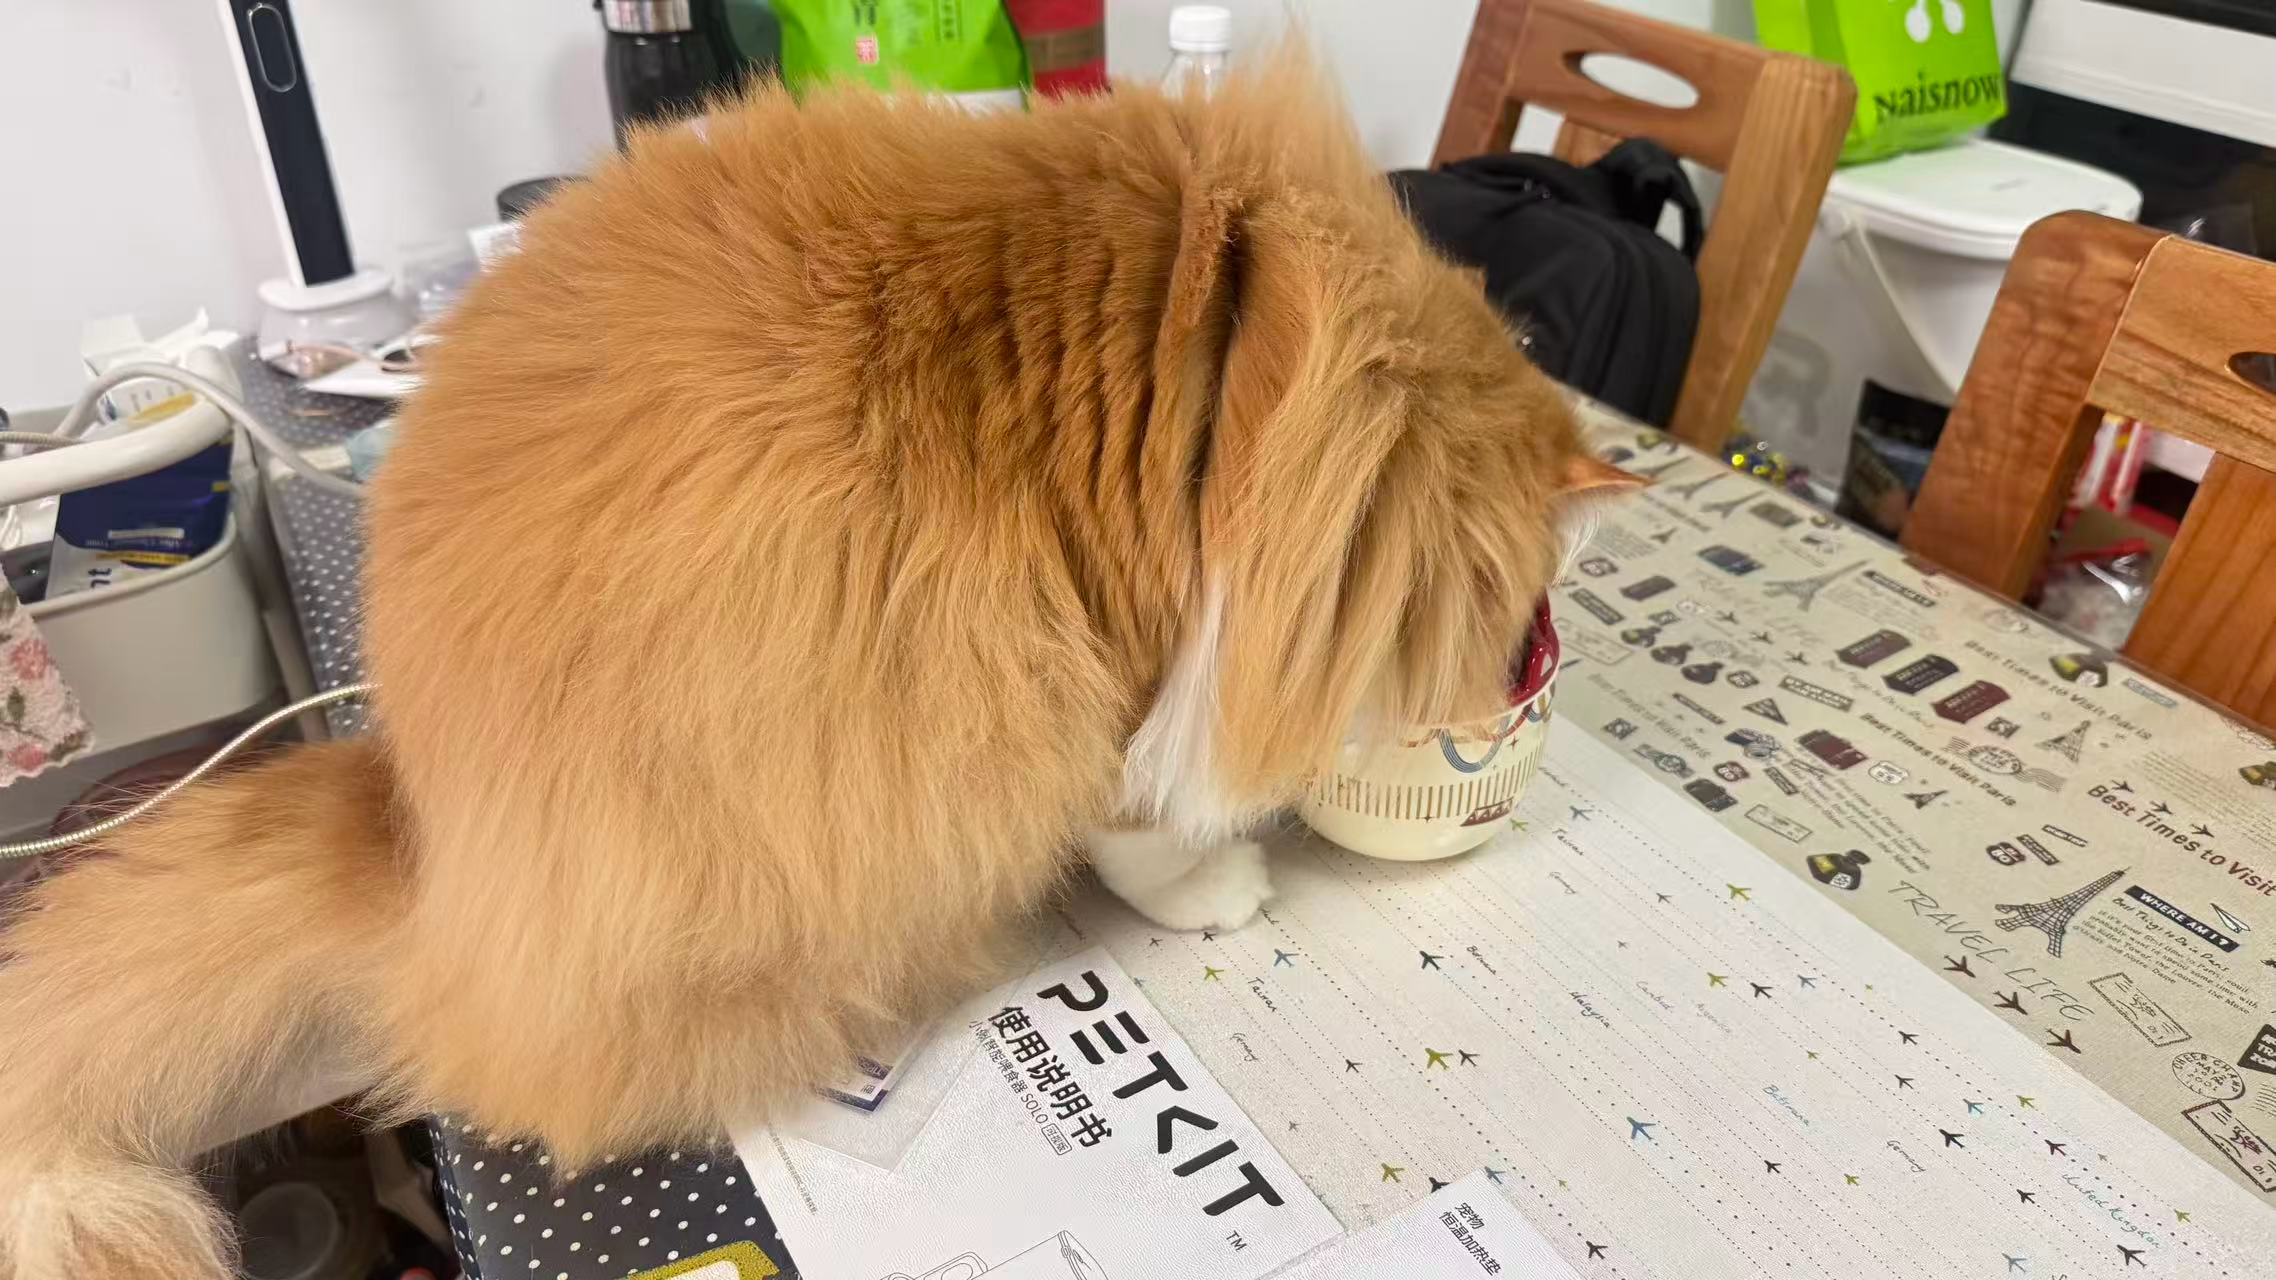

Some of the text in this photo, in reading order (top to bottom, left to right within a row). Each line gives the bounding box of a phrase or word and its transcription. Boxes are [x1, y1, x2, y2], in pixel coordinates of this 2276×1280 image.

[2087, 784, 2276, 897] Best Times to Visit
[1887, 880, 2009, 964] TRAVEL
[2139, 893, 2187, 923] WHERE
[2186, 919, 2209, 936] AM
[2004, 967, 2095, 1021] LIFE
[987, 1006, 1112, 1148] 使用说明书
[1036, 969, 1286, 1217] PETKIT
[1021, 1092, 1049, 1125] SOLO
[1225, 1230, 1248, 1251] TM
[1438, 1211, 1502, 1277] 恒温加热垫
[1454, 1202, 1485, 1230] 宠物
